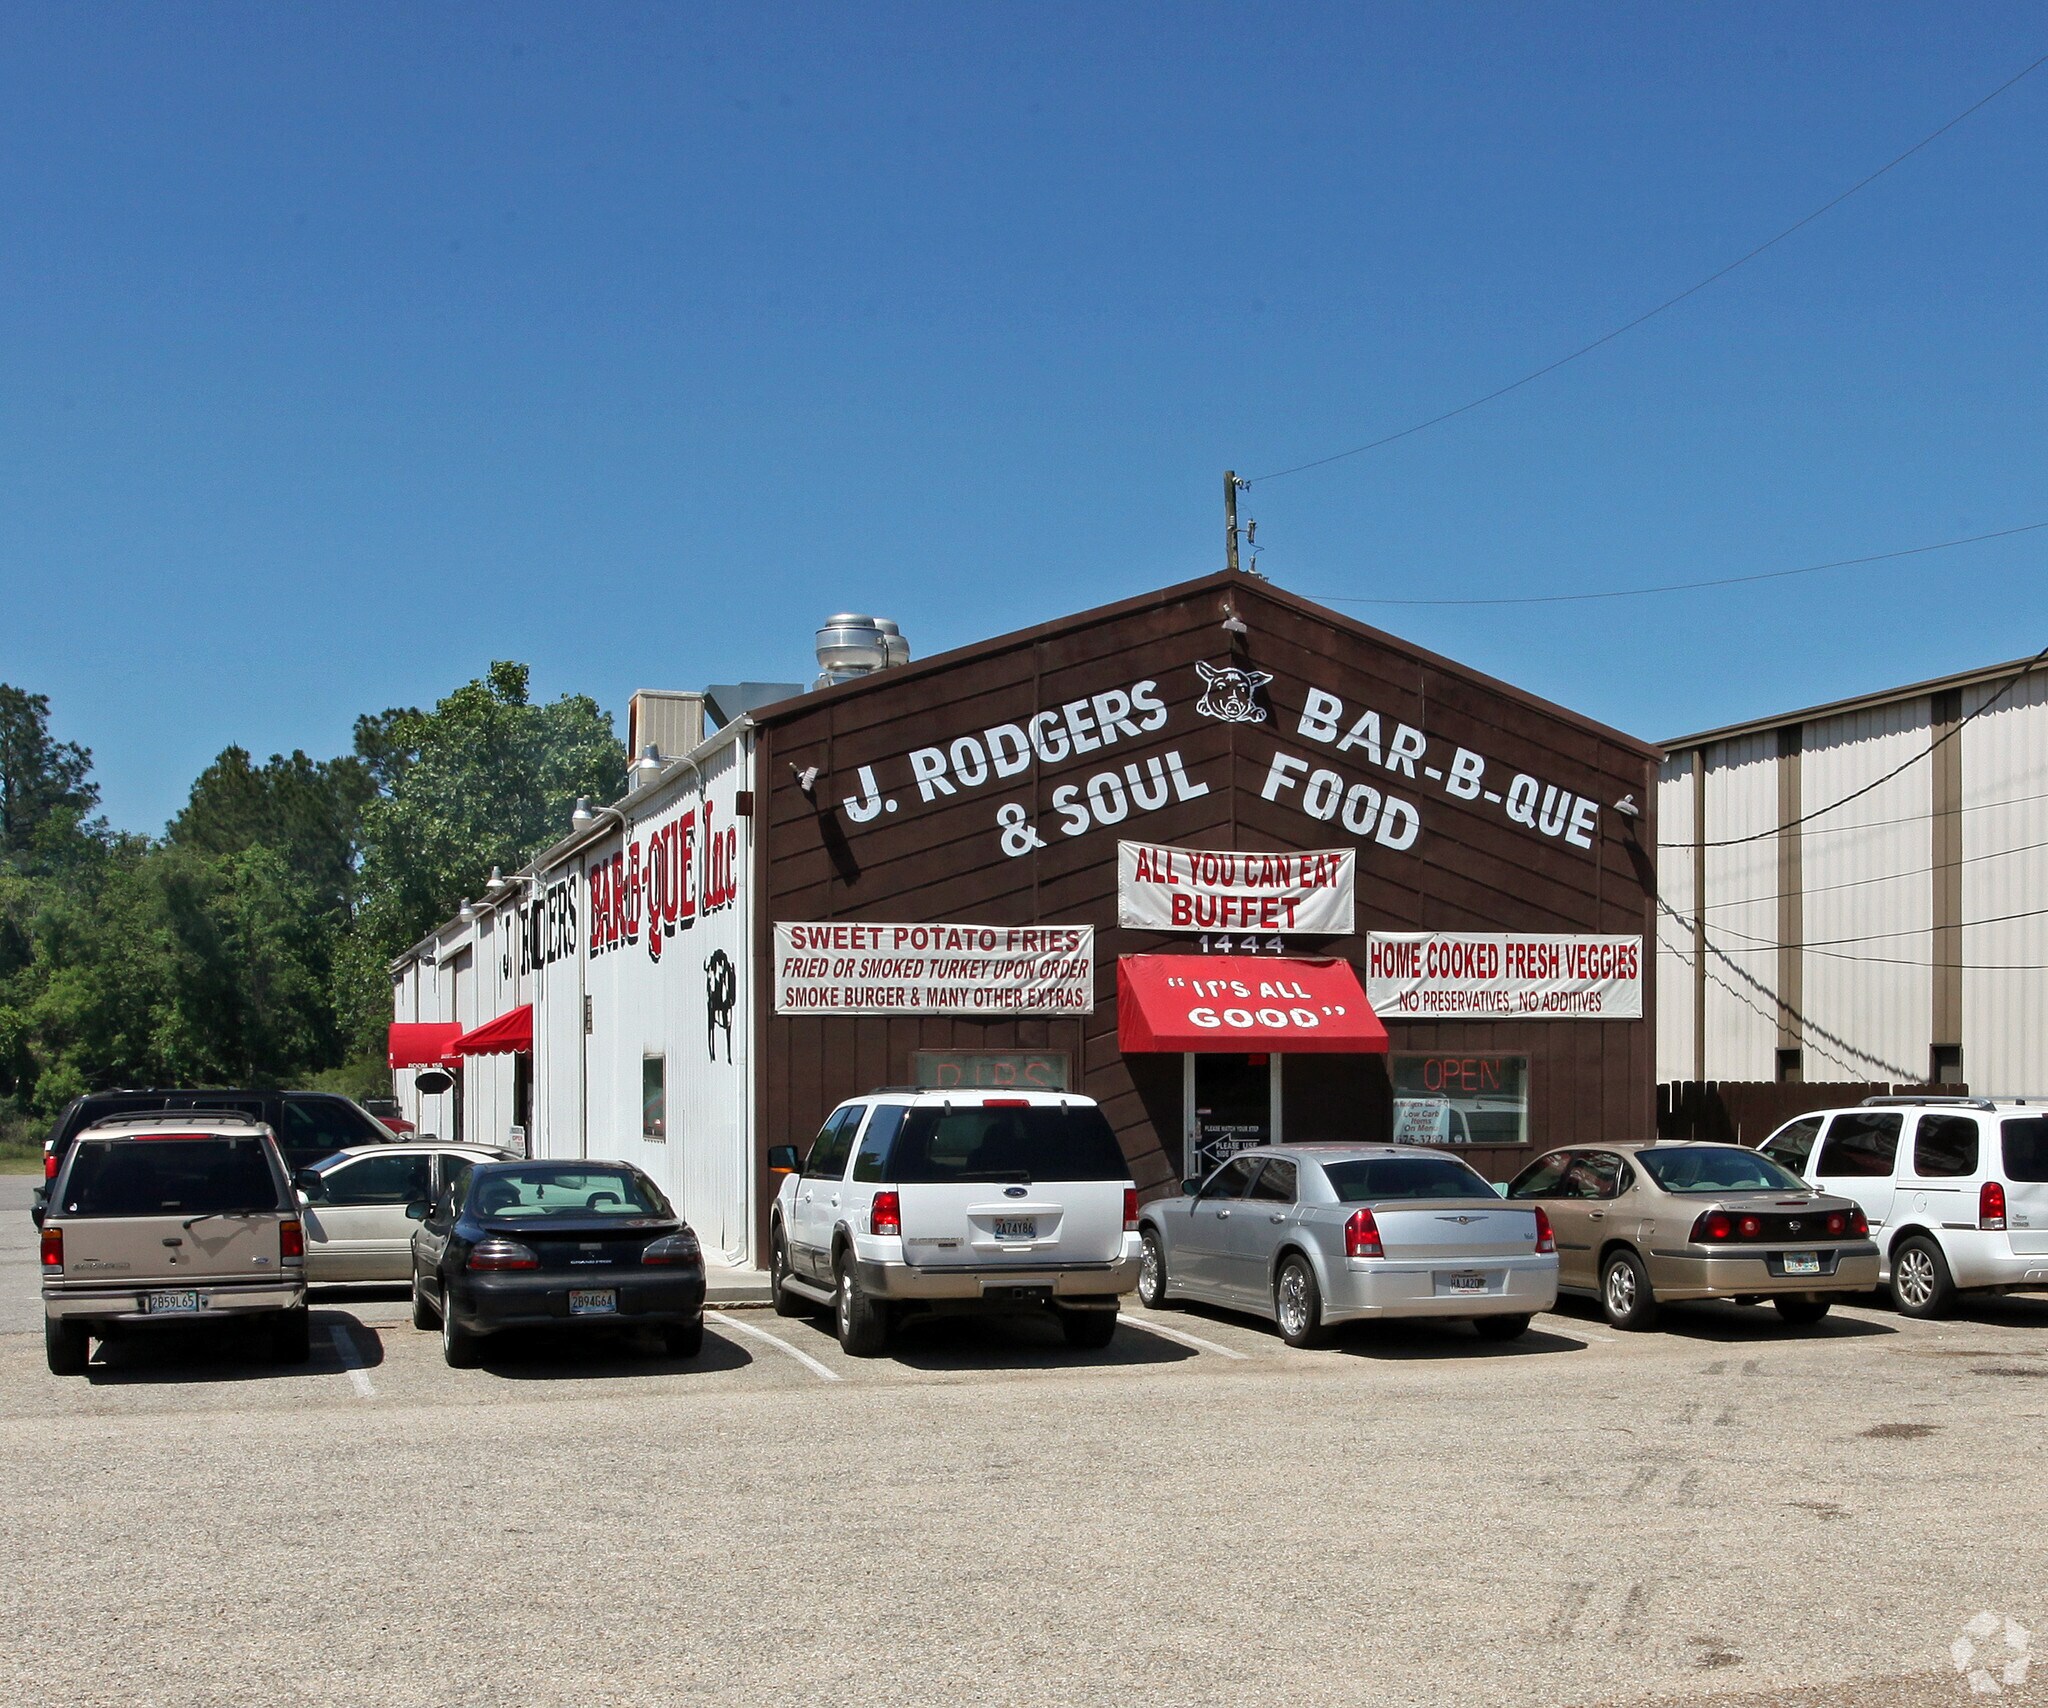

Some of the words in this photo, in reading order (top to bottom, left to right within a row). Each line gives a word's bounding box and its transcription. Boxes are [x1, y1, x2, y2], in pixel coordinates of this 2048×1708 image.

[843, 765, 898, 823] J.
[909, 680, 1168, 802] RODGERS
[1297, 687, 1600, 850] BAR-B-QUE
[997, 803, 1047, 857] &
[1052, 751, 1210, 837] SOUL
[1260, 751, 1420, 851] FOOD
[1135, 847, 1179, 884] ALL
[1186, 852, 1236, 887] YOU
[1244, 855, 1291, 888] CAN
[1299, 854, 1342, 888] EAT
[590, 807, 696, 963] BAR-B-QUE
[1171, 893, 1301, 929] BUFFET
[790, 926, 884, 950] SWEET
[894, 927, 997, 950] POTATO
[1007, 929, 1080, 952] FRIES
[1198, 934, 1284, 954] 1444
[782, 958, 829, 979] FRIED
[833, 958, 855, 979] OR
[858, 958, 924, 979] SMOKED
[929, 959, 990, 979] TURKEY
[993, 959, 1036, 979] UPON
[1039, 958, 1089, 979] ORDER
[1370, 942, 1421, 979] HOME
[1427, 942, 1498, 979] COOKED
[1505, 943, 1559, 979] FRESH
[1565, 944, 1638, 980] VEGGIES
[786, 987, 839, 1007] SMOKE
[844, 987, 905, 1007] BURGER
[910, 987, 920, 1007] &
[927, 987, 969, 1007] MANY
[974, 988, 1023, 1008] OTHER
[1027, 988, 1084, 1008] EXTRAS
[1259, 980, 1312, 999] ALL
[1399, 991, 1420, 1011] NO
[1423, 991, 1513, 1013] PRESERVATIVES,
[1519, 991, 1539, 1011] NO
[1542, 991, 1602, 1012] ADDITIVES
[1424, 1058, 1501, 1091] OPEN
